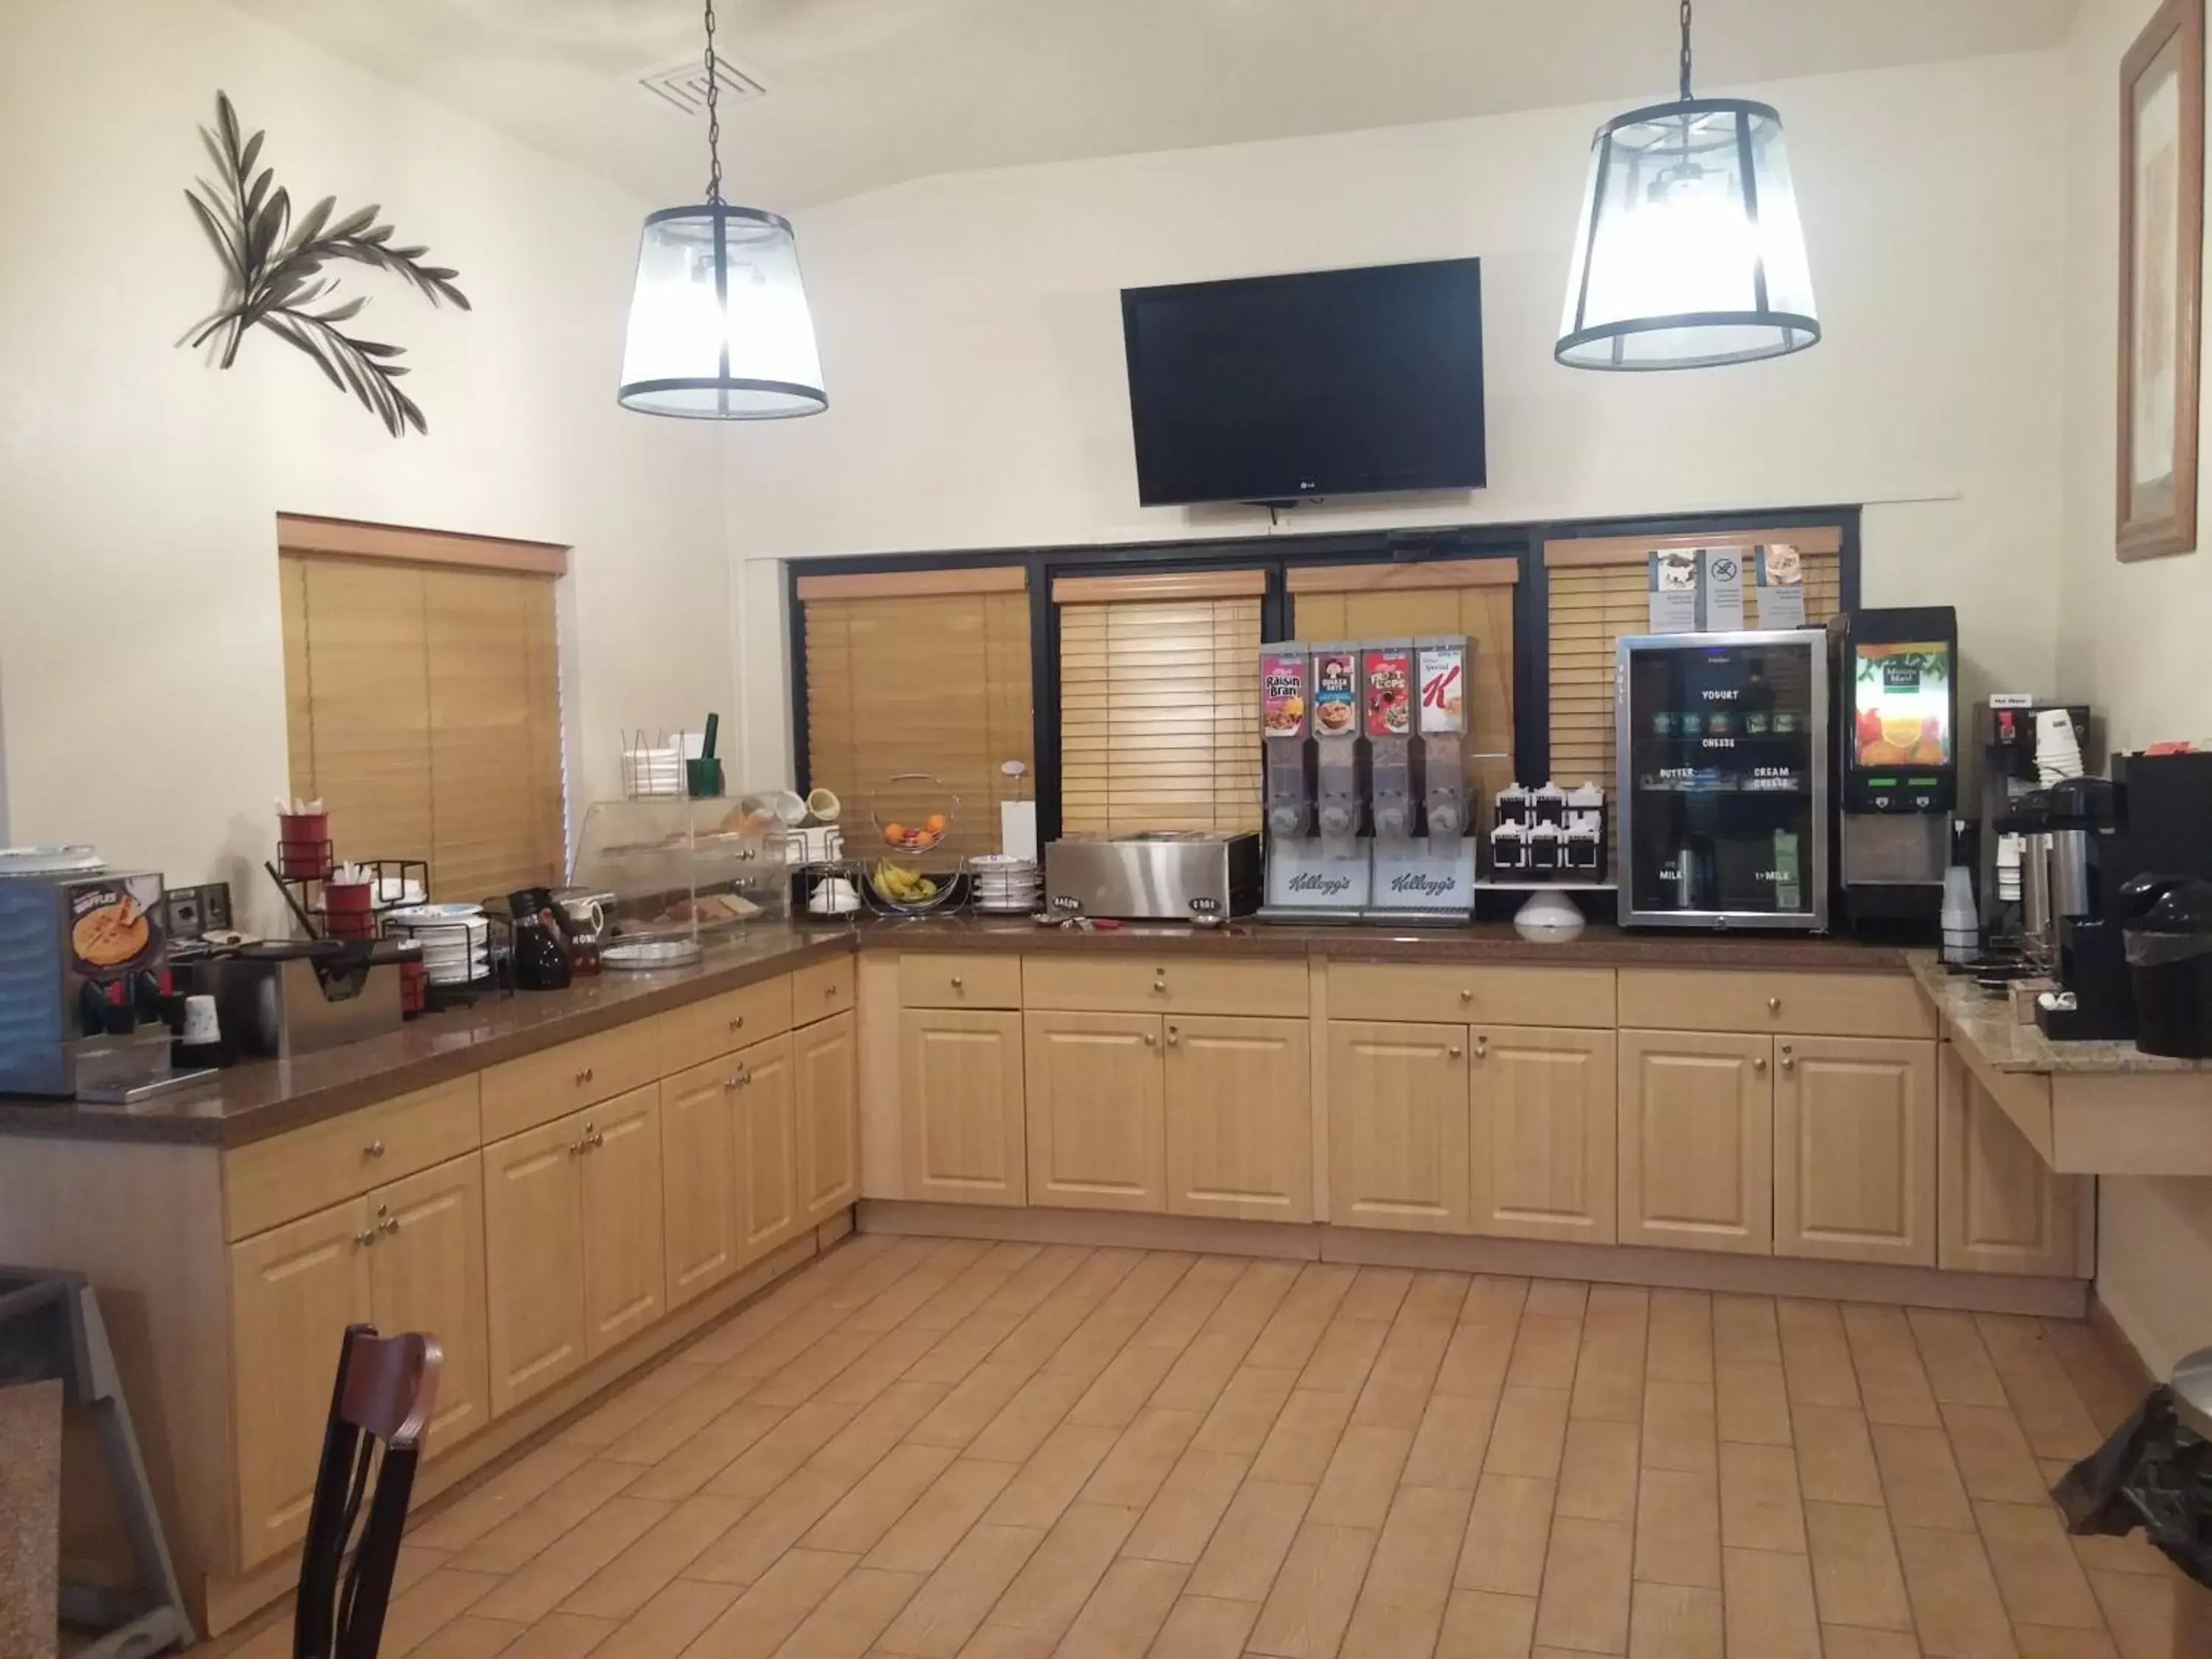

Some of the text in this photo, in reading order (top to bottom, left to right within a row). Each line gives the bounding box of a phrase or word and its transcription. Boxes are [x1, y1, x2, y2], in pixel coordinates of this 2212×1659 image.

[1265, 675, 1301, 689] Raisin
[1422, 665, 1461, 709] K
[1270, 686, 1298, 698] Bran
[1701, 690, 1739, 700] YOGURT
[1702, 738, 1735, 748] CHEESE
[1660, 768, 1694, 778] BUTTER
[1753, 768, 1790, 777] CREAM
[1765, 872, 1790, 881] MILK
[1289, 872, 1351, 895] Kellogg's
[1392, 872, 1456, 896] Kellogg's
